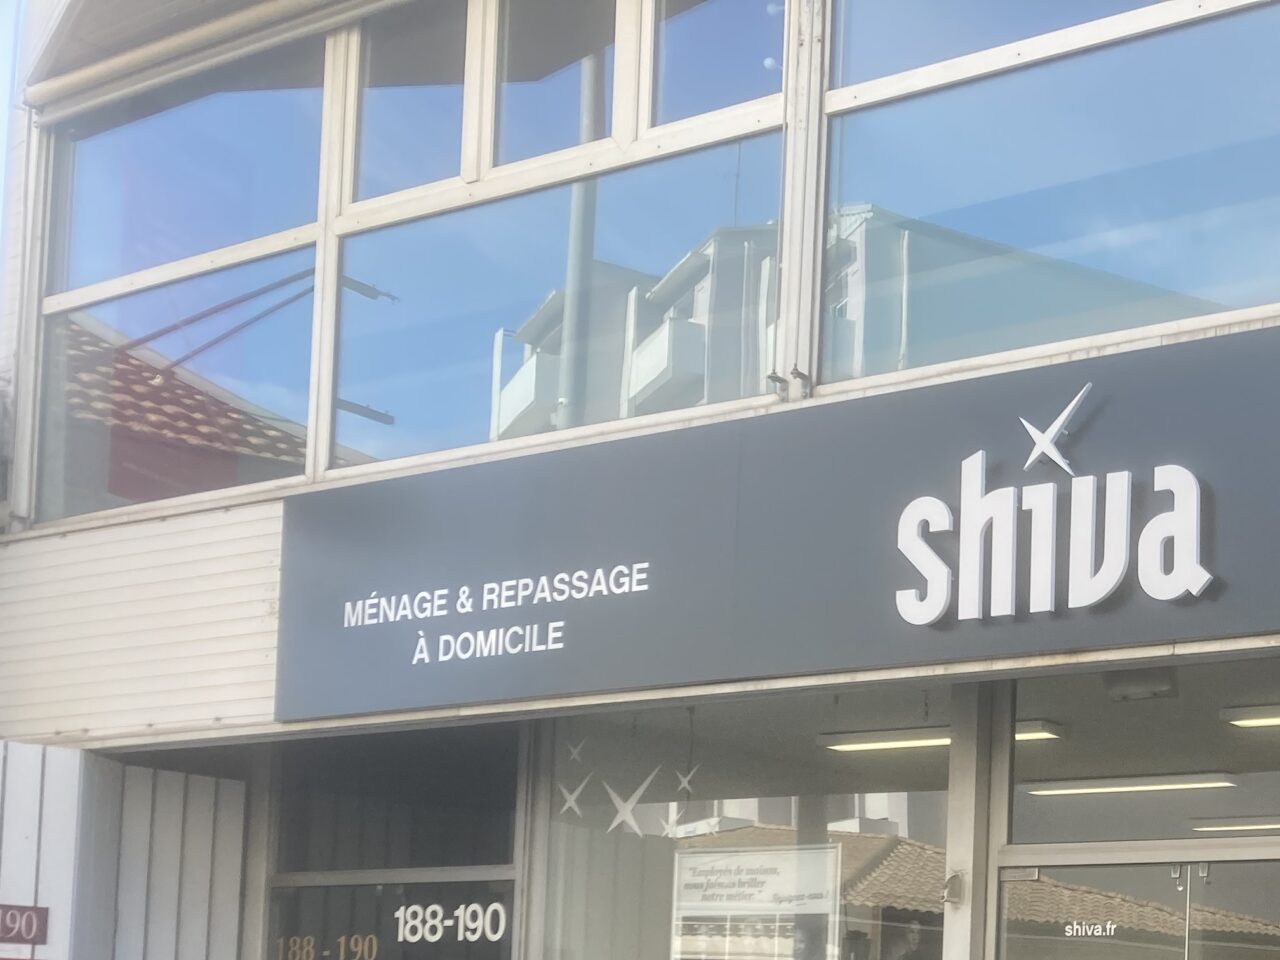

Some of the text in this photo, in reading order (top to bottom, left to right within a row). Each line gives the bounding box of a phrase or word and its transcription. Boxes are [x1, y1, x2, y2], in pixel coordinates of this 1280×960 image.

[895, 382, 1214, 626] shiva
[343, 562, 650, 628] MÉNAGE & REPASSAGE
[411, 621, 565, 665] À DOMICILE
[394, 902, 506, 943] 188-190
[1064, 921, 1117, 937] shiva.fr
